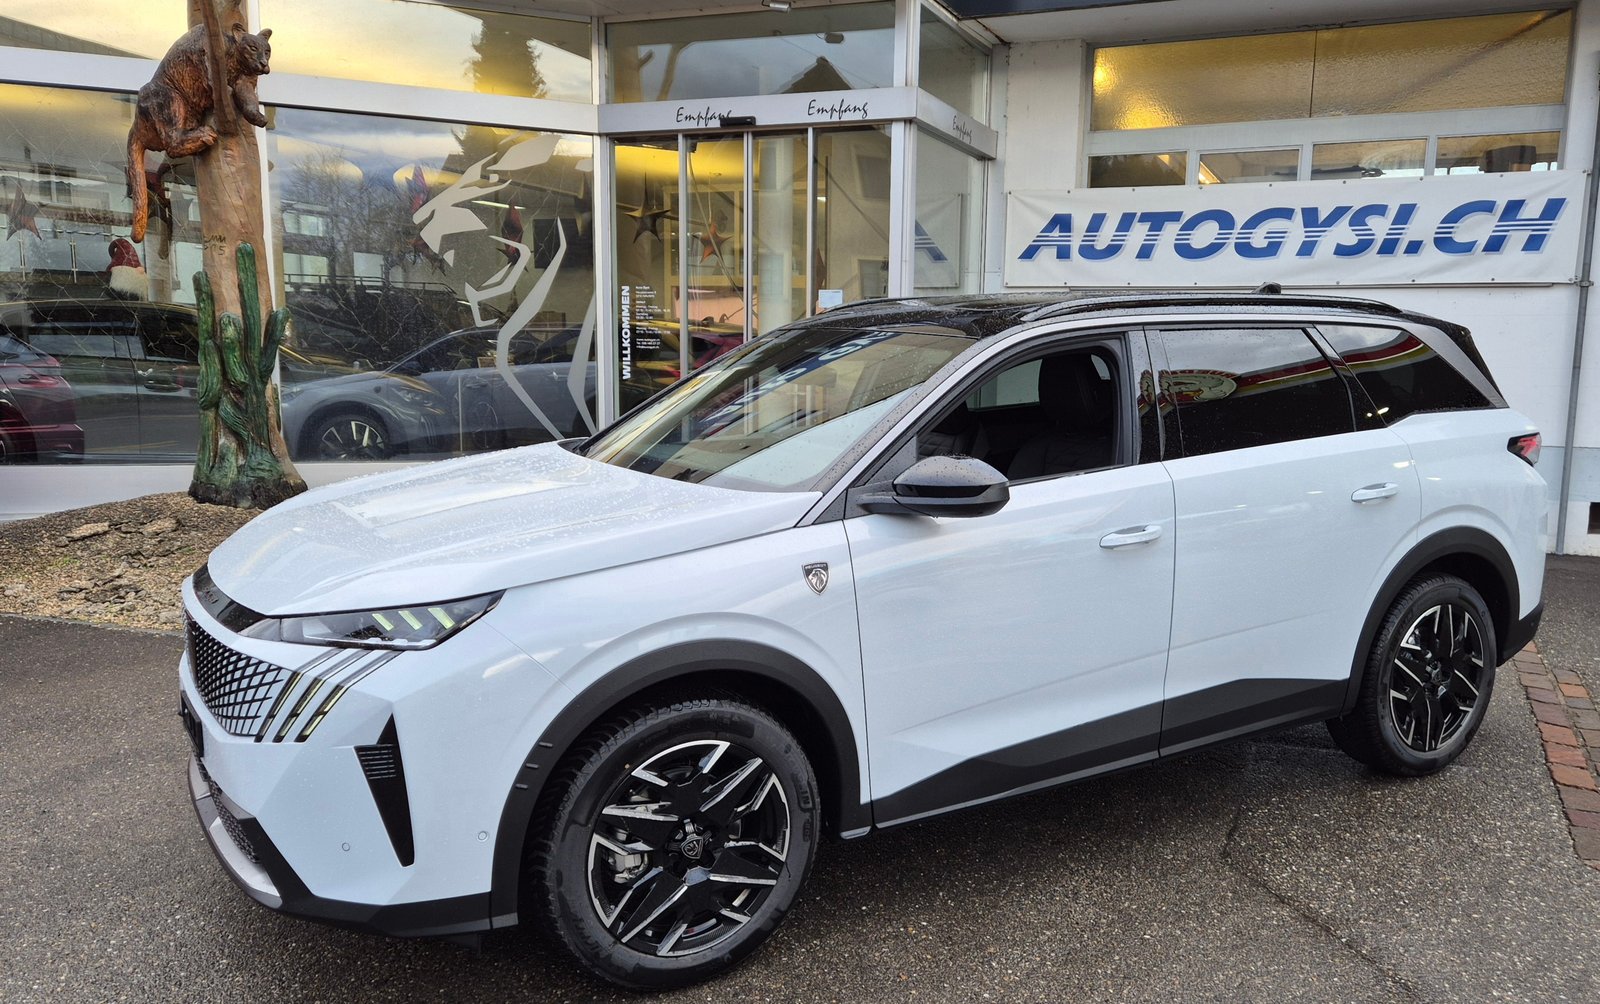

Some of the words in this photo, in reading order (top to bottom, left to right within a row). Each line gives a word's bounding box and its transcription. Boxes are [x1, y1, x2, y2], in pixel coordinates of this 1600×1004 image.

[676, 106, 732, 127] Empfan
[807, 98, 869, 120] Empfang
[952, 115, 973, 144] Empfang
[1017, 197, 1568, 261] AUTOGYSI.CH
[621, 285, 631, 380] WILLKOMMEN
